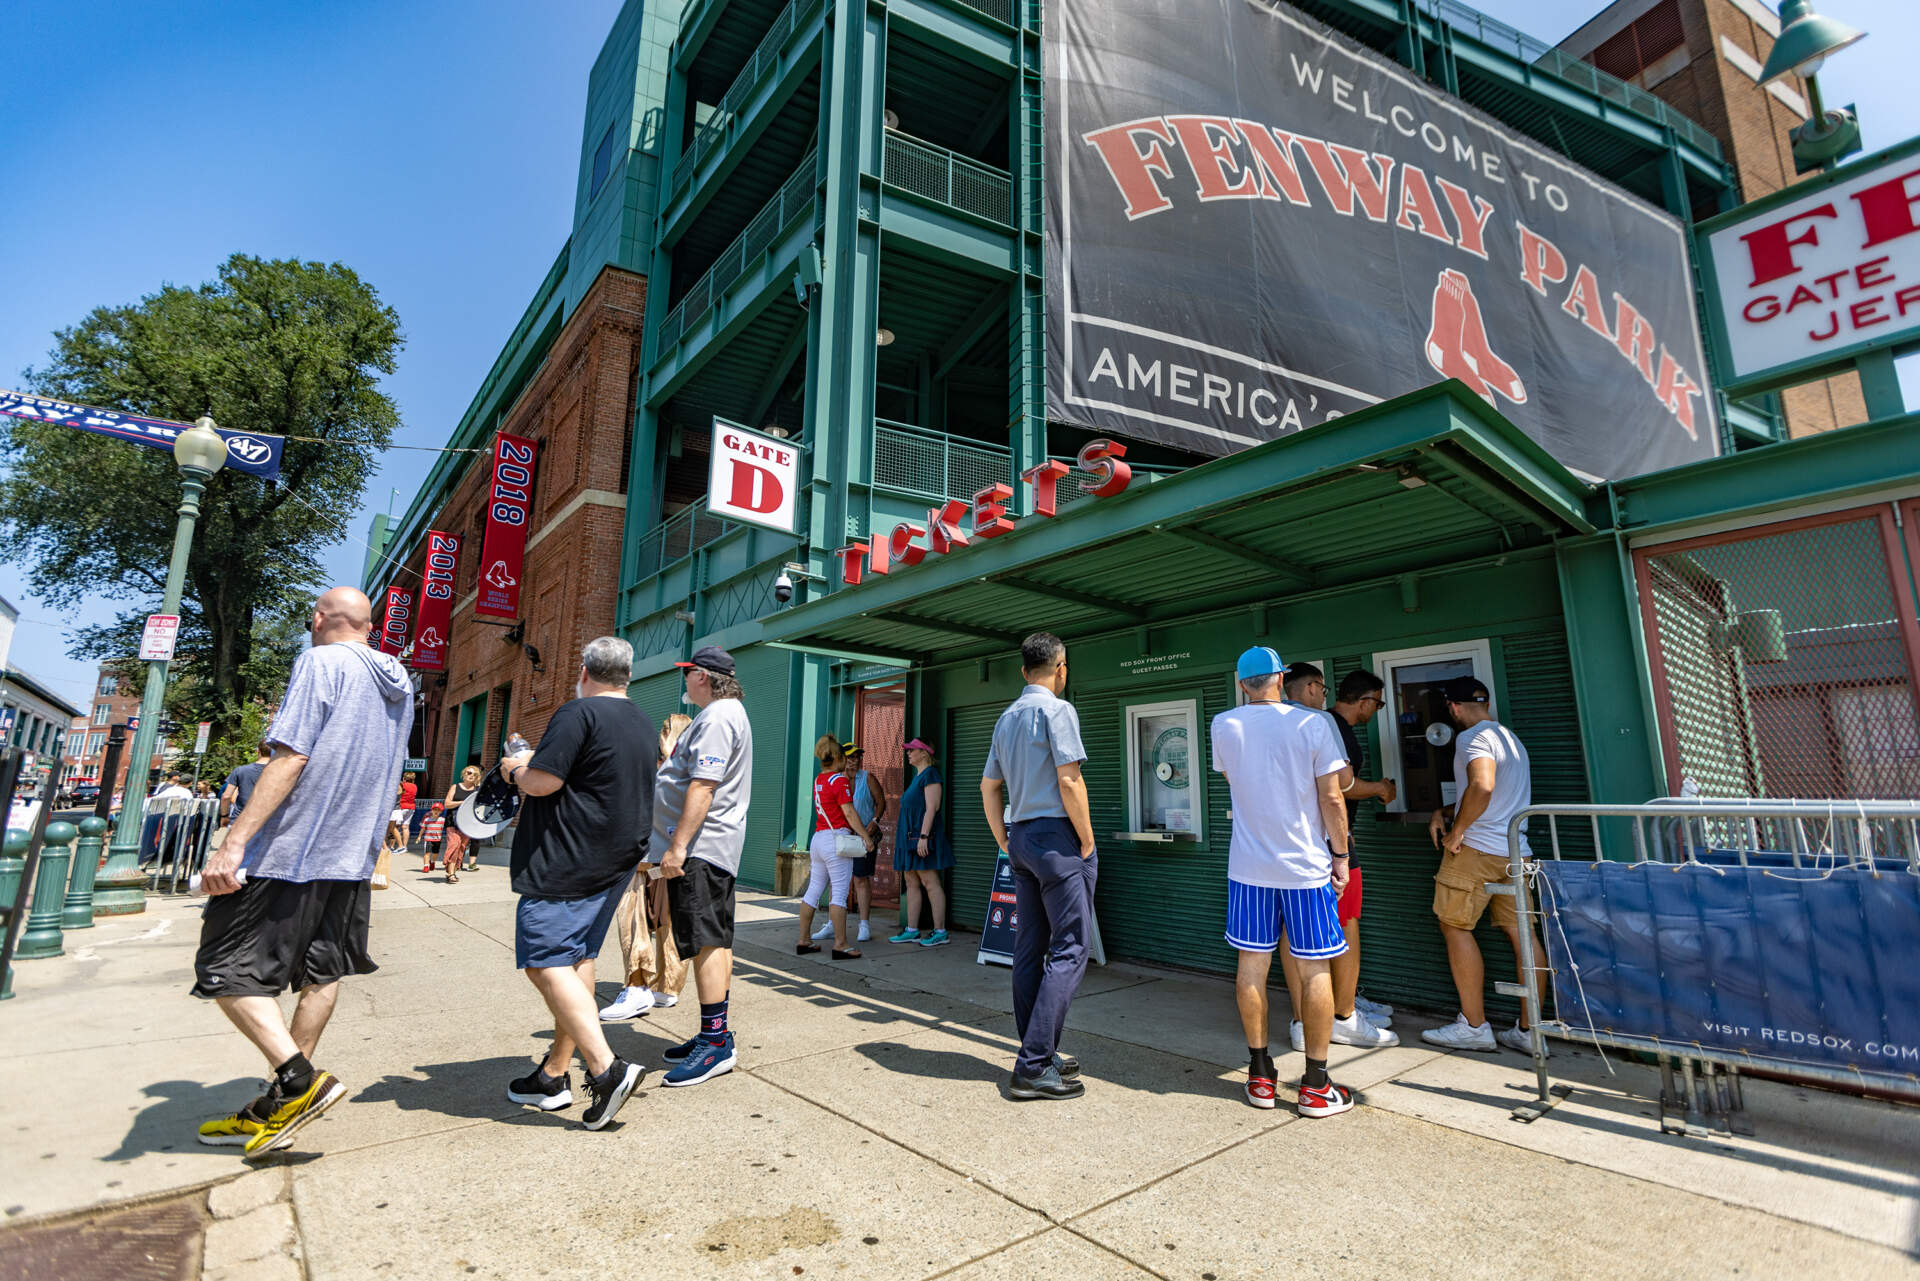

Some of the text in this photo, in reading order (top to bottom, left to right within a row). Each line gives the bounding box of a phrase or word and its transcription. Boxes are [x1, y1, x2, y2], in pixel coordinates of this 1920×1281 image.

[1290, 53, 1569, 212] WELCOME TO
[1083, 114, 1702, 441] FENWAY PARK
[1743, 256, 1896, 323] GATE
[85, 416, 186, 438] PAR
[93, 410, 121, 419] TO
[723, 433, 790, 467] GATE
[492, 439, 533, 526] 2018
[727, 458, 784, 514] D
[835, 438, 1132, 585] TICKETS
[425, 535, 457, 600] 2013
[385, 592, 411, 648] 2007
[1132, 663, 1178, 674] GUEST PASSES
[1146, 655, 1167, 663] FRONT
[1167, 652, 1191, 661] OFFICE
[1703, 1021, 1920, 1063] VISIT REDSOX.COM
